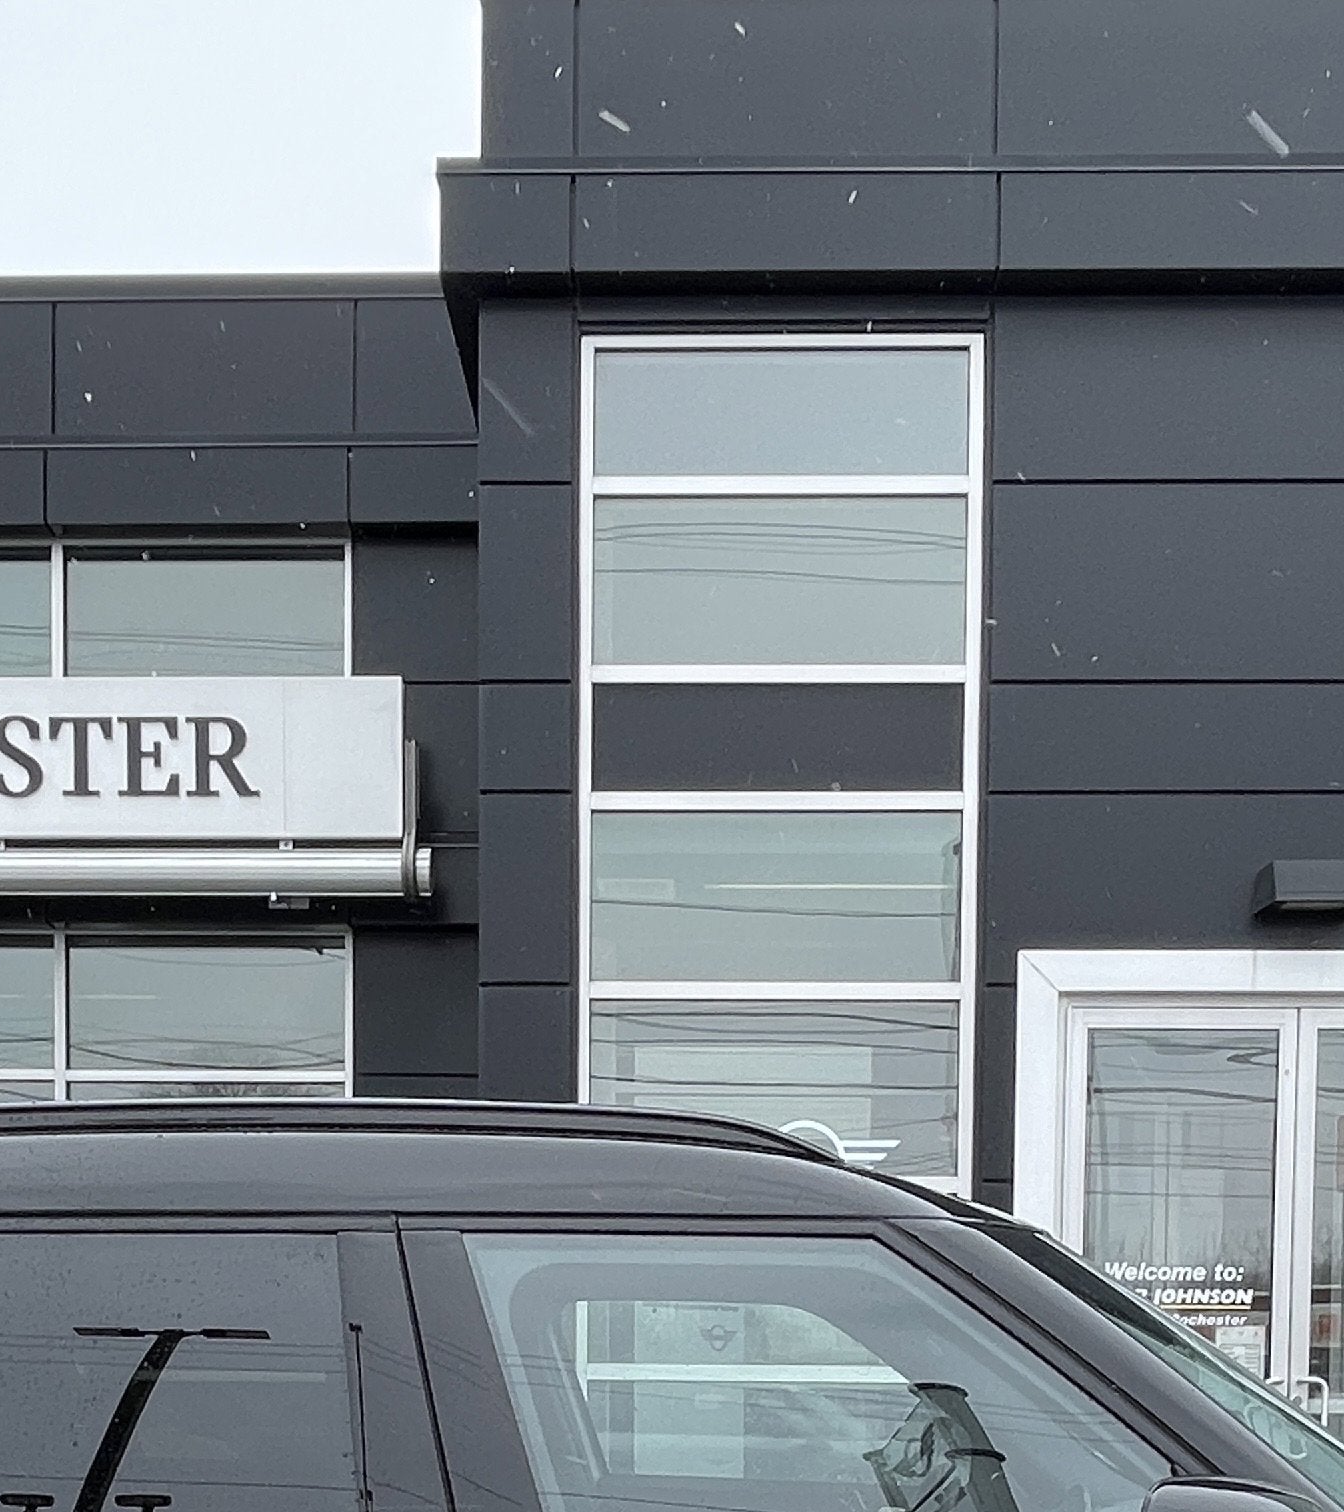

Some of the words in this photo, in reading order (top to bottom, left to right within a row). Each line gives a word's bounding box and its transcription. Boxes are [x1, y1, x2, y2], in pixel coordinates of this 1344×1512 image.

[1104, 1261, 1206, 1282] Welcome
[1213, 1263, 1245, 1282] to:
[1153, 1288, 1254, 1305] JOHNSON
